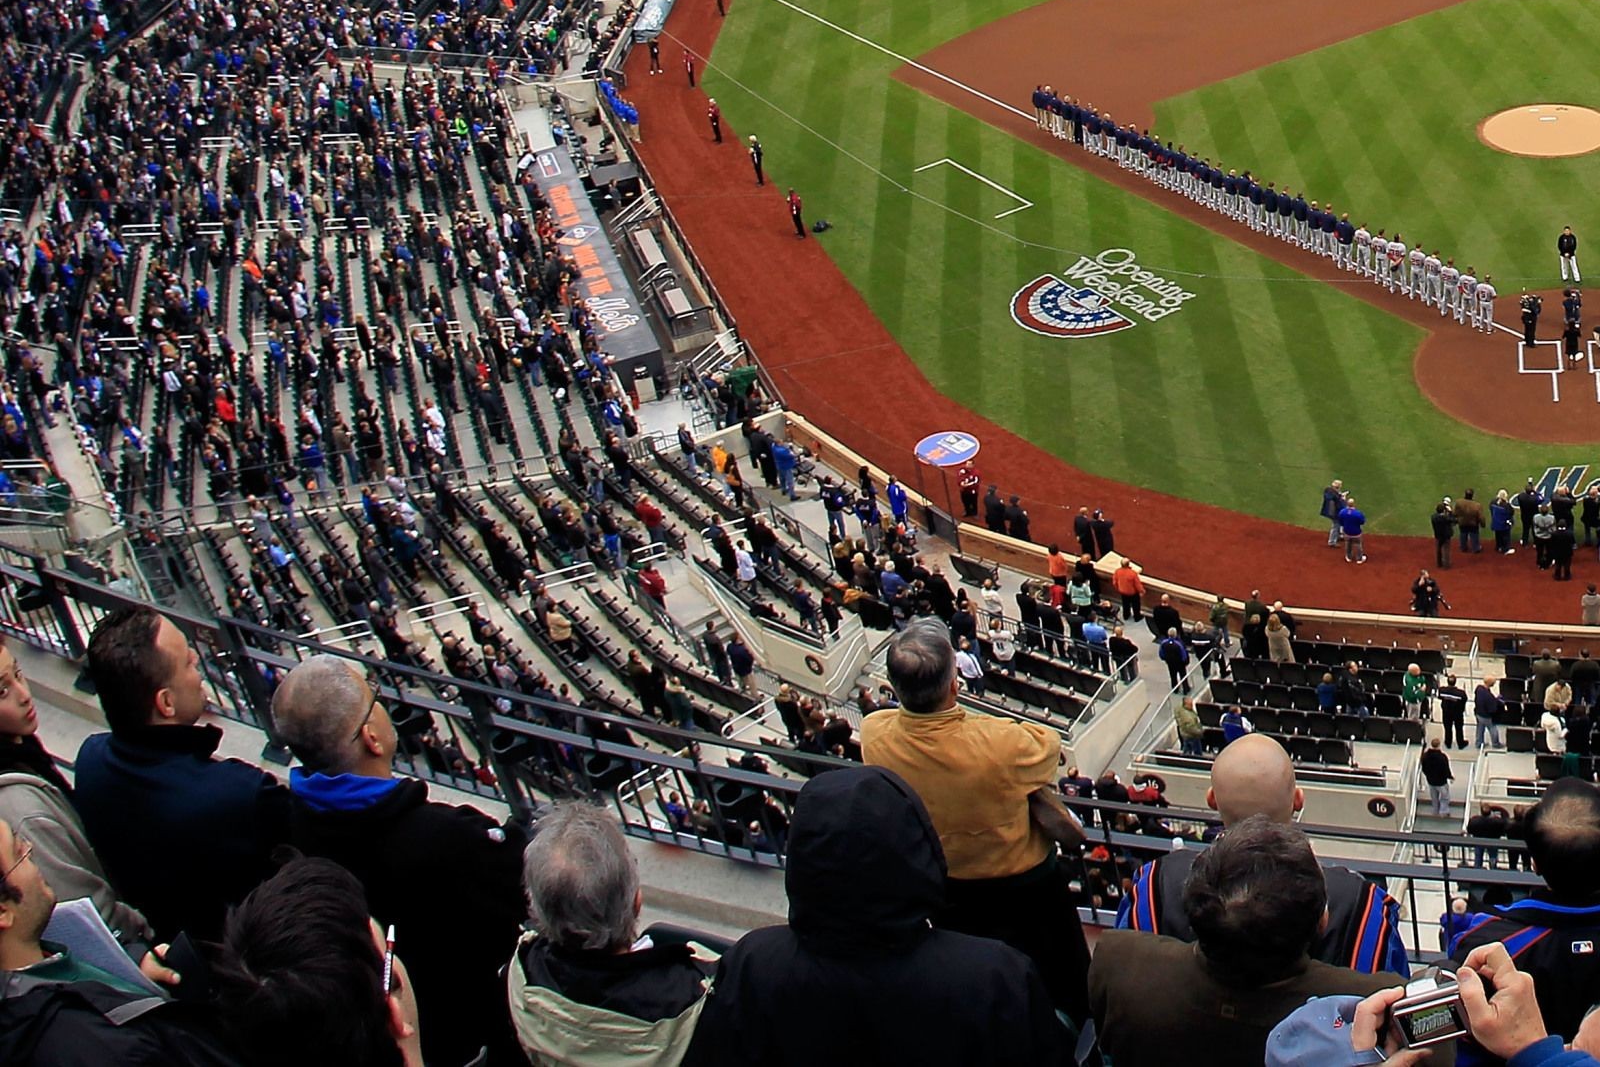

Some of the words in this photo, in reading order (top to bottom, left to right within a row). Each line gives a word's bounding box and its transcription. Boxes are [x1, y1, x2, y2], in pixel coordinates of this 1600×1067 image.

[1064, 256, 1181, 321] Weekend
[1096, 248, 1196, 307] Opening
[585, 296, 639, 332] Mets
[1147, 779, 1158, 790] 16
[1376, 802, 1387, 813] 16
